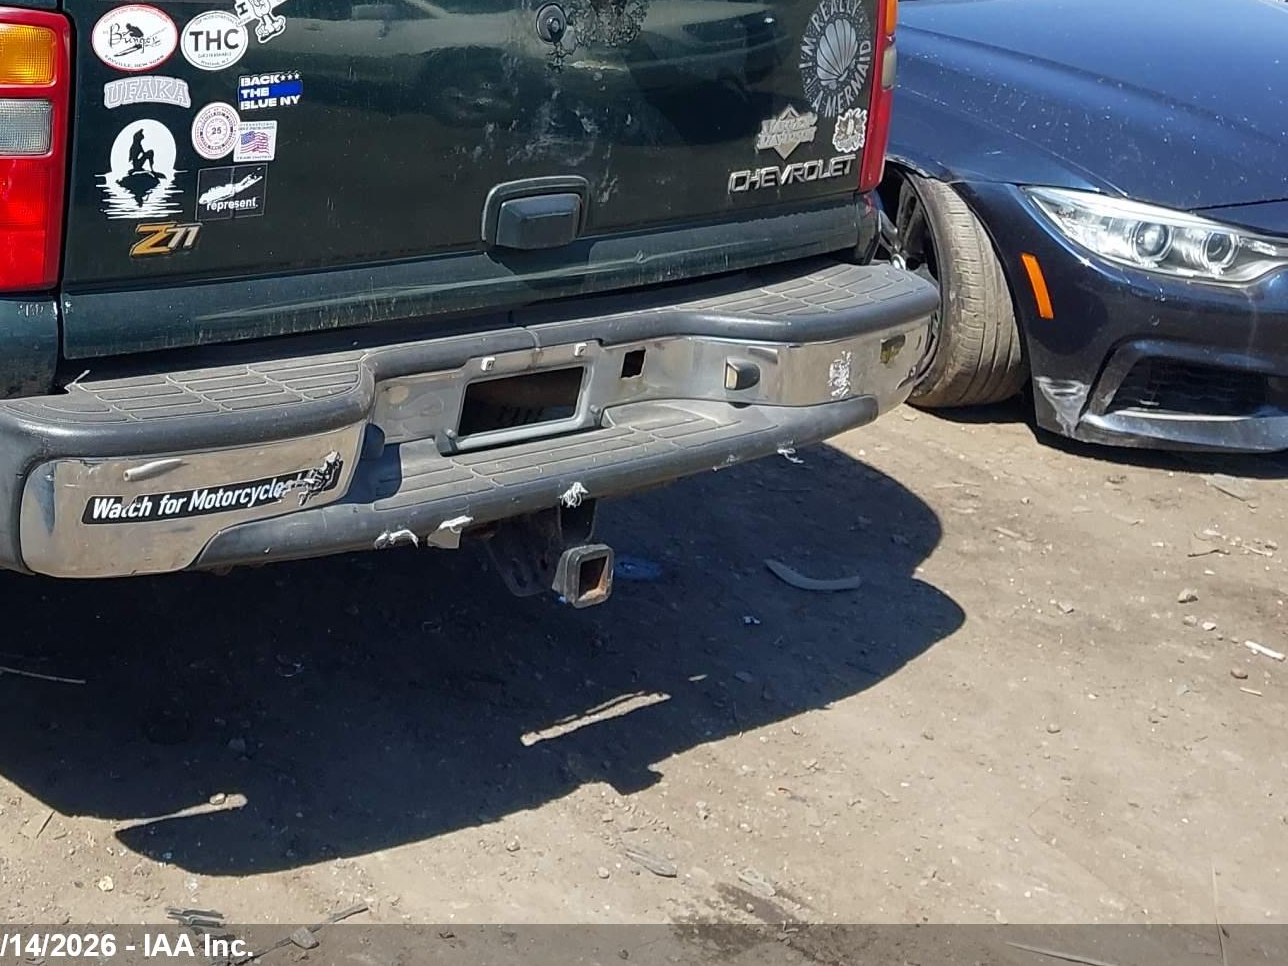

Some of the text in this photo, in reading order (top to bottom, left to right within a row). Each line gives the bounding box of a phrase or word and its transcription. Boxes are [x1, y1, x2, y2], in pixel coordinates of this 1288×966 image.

[189, 28, 240, 52] THC
[240, 74, 281, 87] BACK
[824, 39, 872, 118] MERMAID
[106, 77, 189, 105] UFAKA
[240, 87, 270, 99] THE
[240, 94, 302, 111] BLUE NY
[211, 127, 222, 135] 25
[728, 154, 856, 193] CHEVROLET
[92, 497, 152, 520] Watch
[157, 494, 188, 515] for
